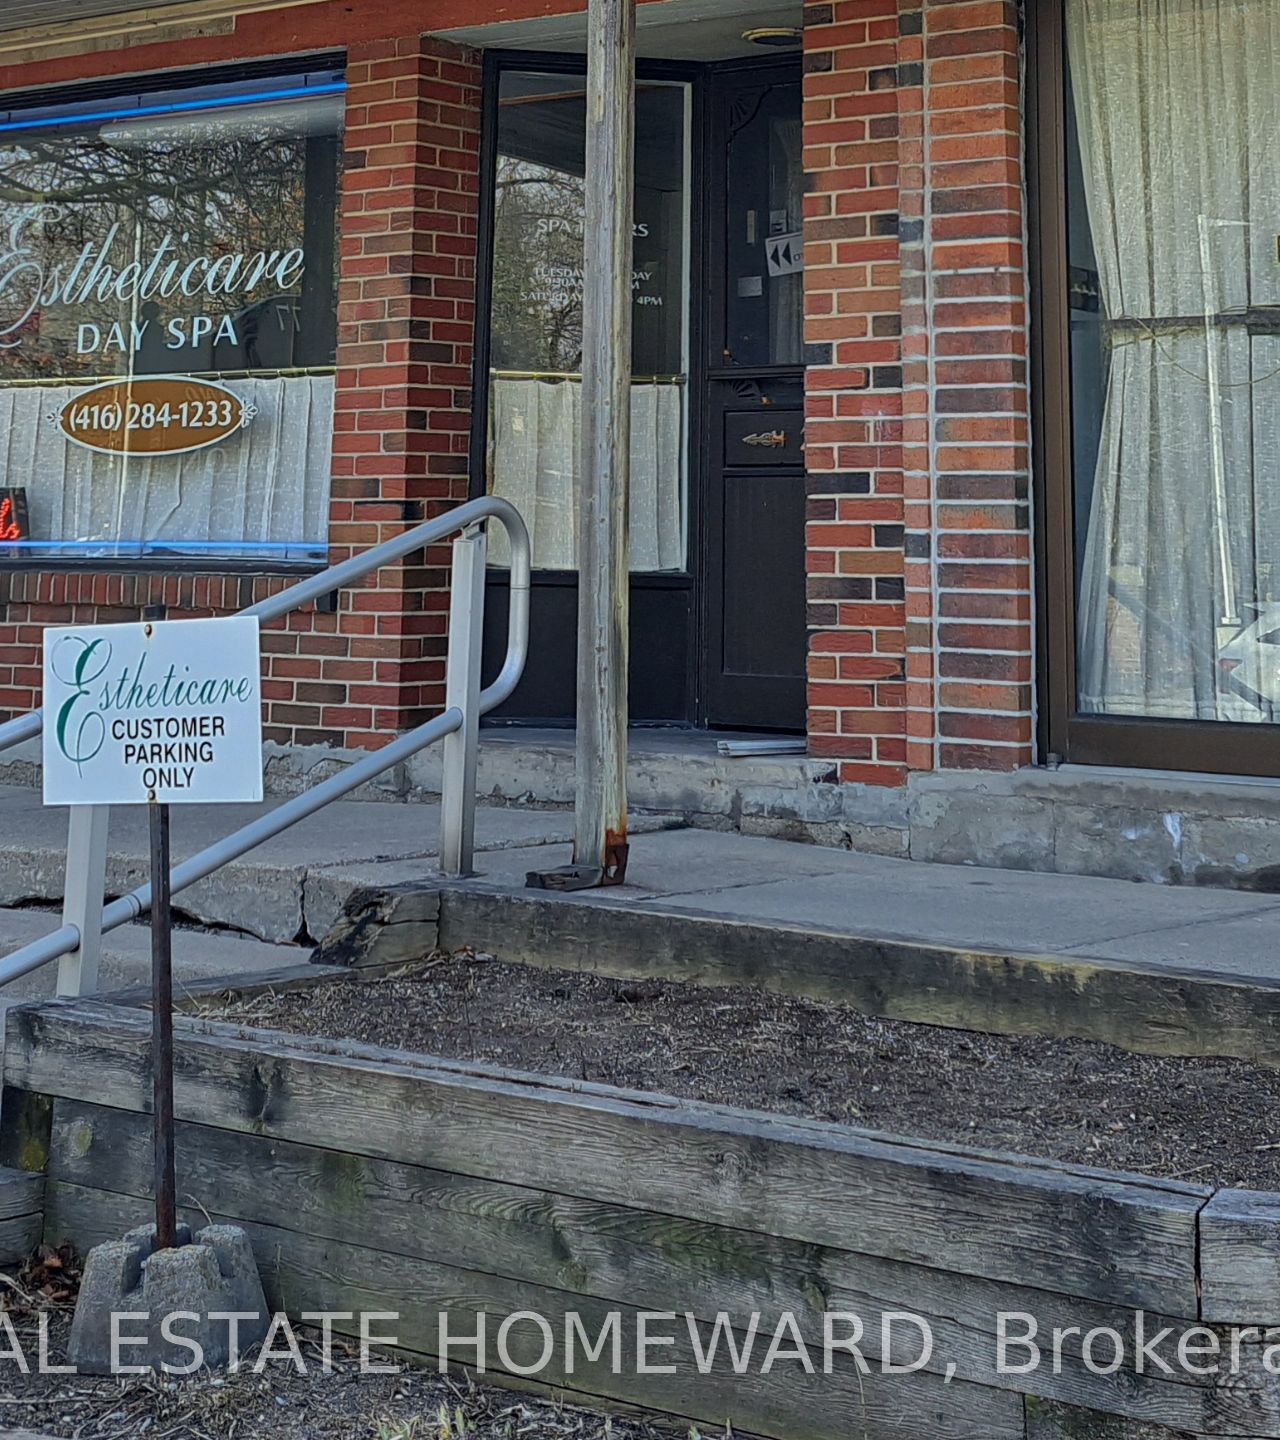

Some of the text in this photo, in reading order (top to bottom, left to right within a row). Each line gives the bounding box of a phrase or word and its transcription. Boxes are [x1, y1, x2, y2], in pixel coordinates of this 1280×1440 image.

[536, 218, 571, 233] SPA
[637, 296, 662, 306] 4PM
[77, 315, 239, 354] DAY SPA
[69, 399, 233, 432] (416) 284-1233
[51, 635, 253, 779] Estheticare
[112, 716, 226, 740] CUSTOMER
[124, 741, 214, 764] PARKING
[142, 767, 195, 788] ONLY
